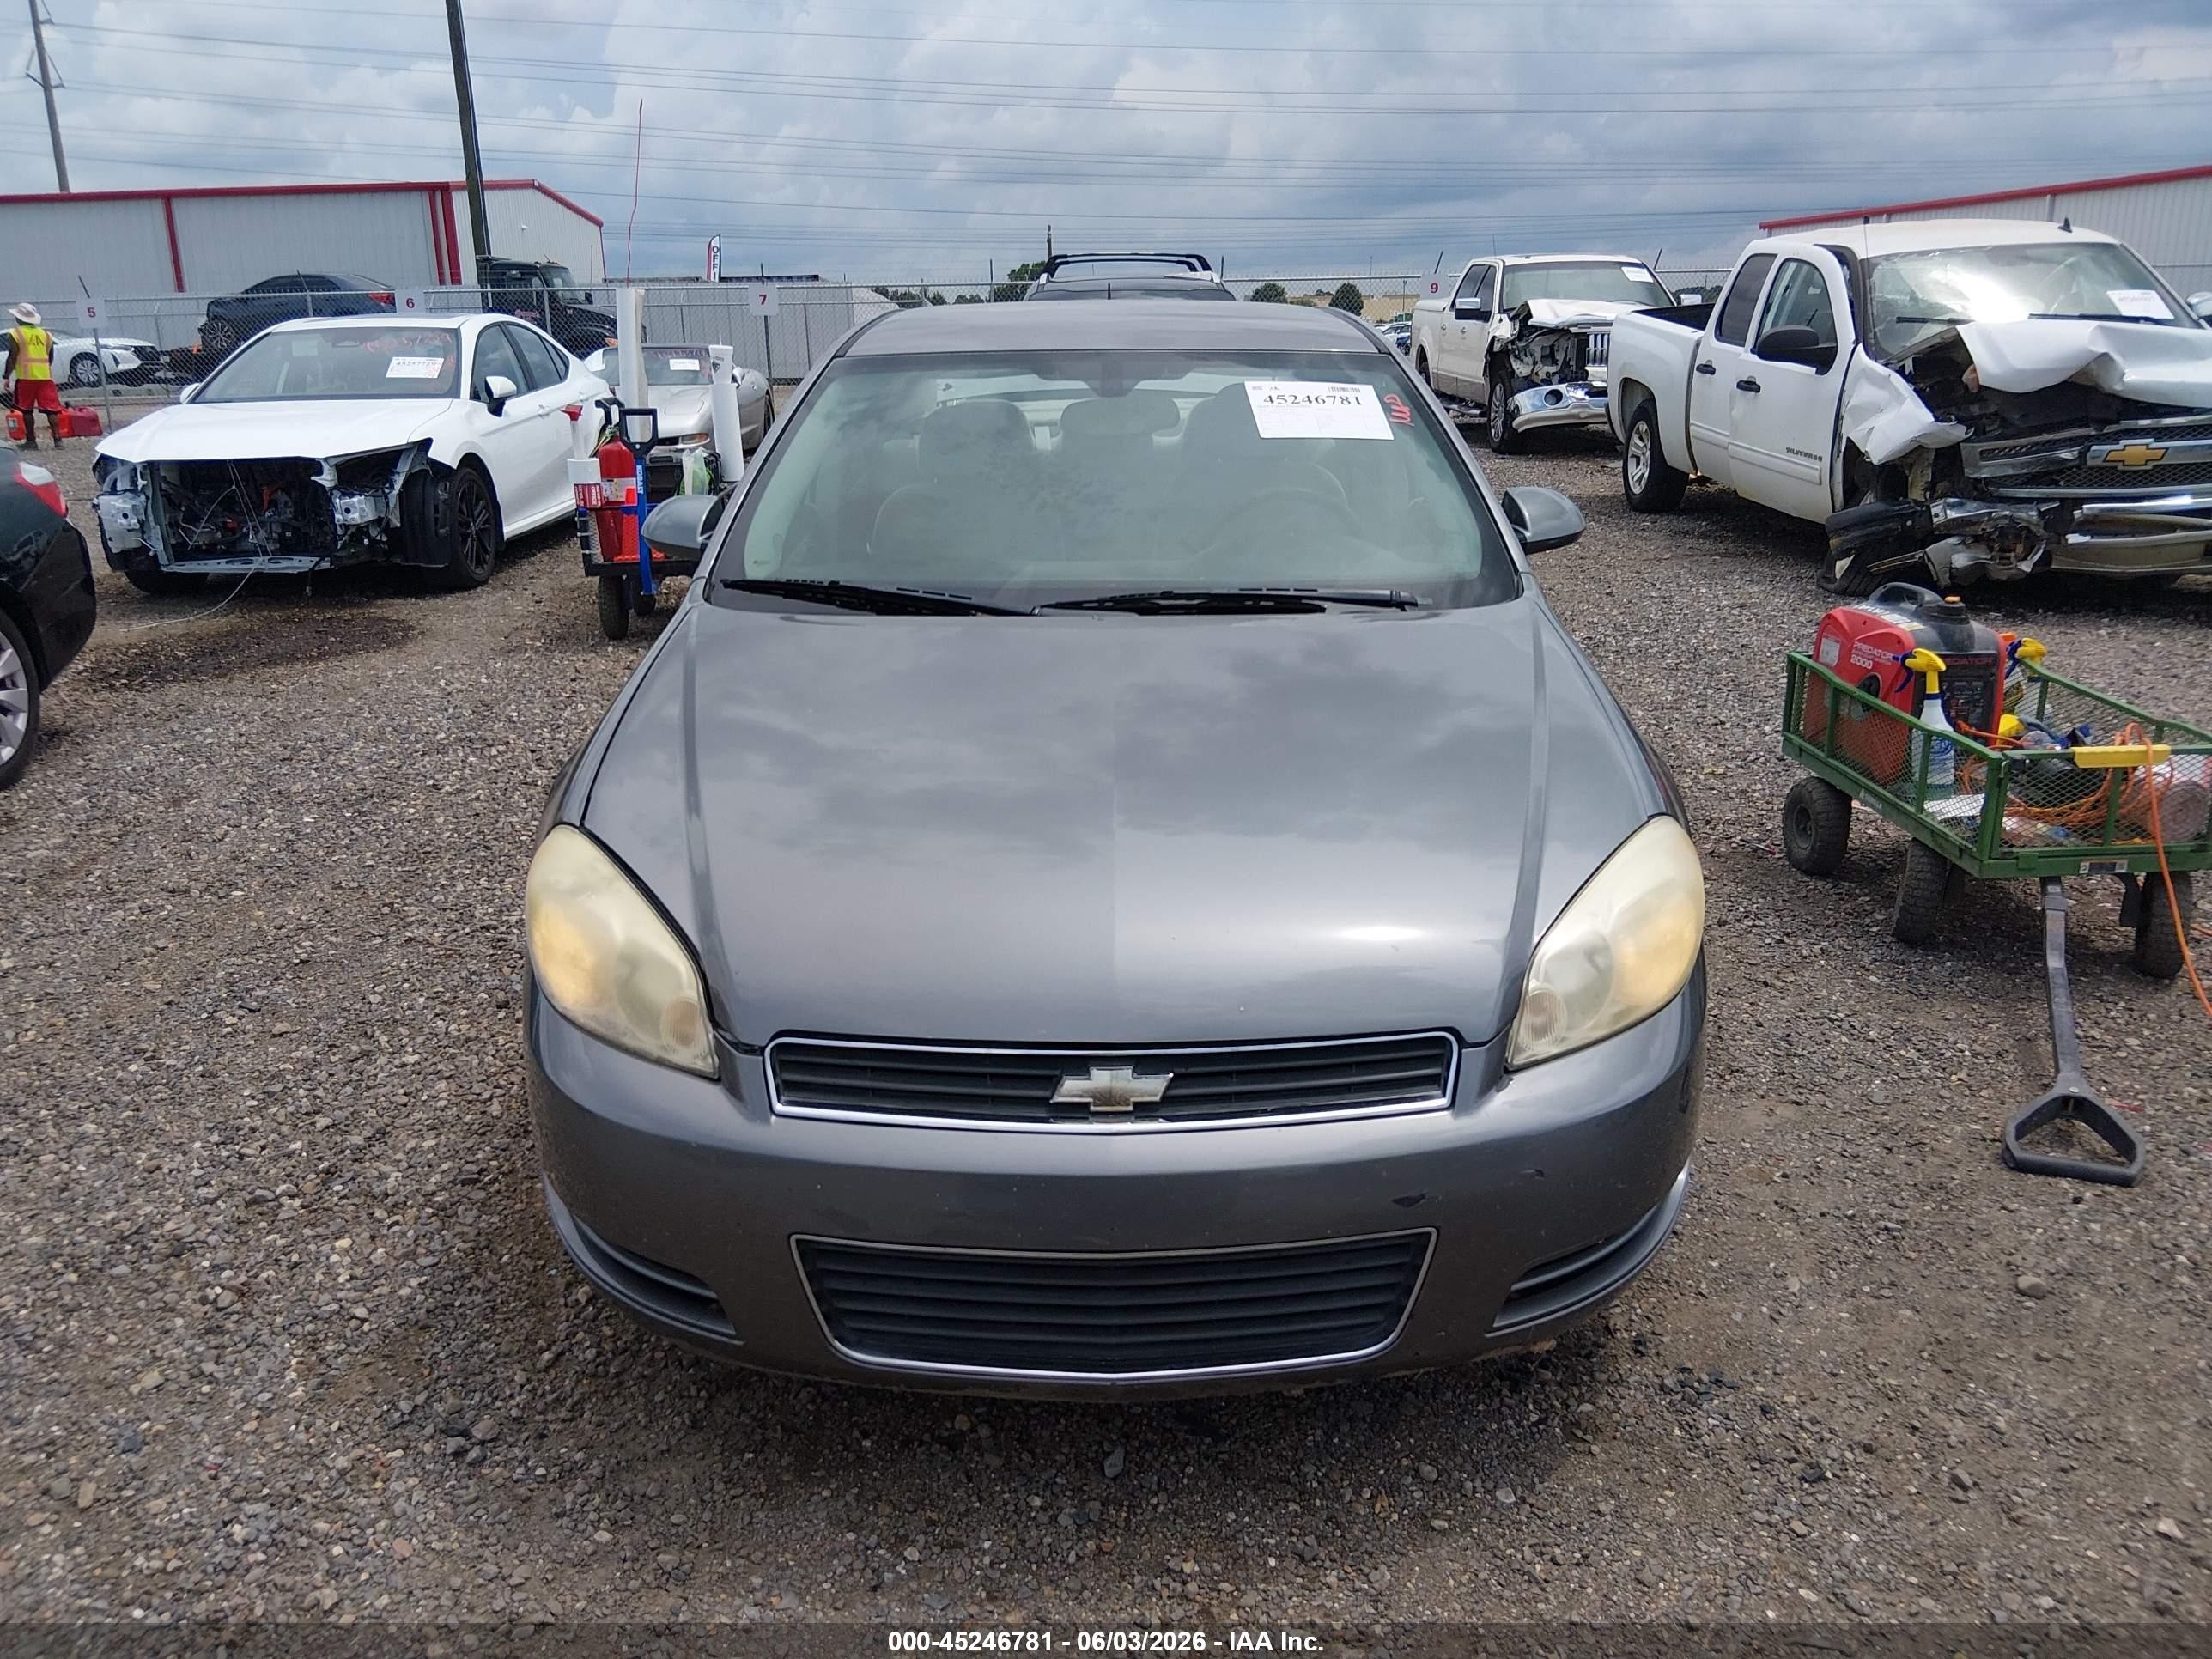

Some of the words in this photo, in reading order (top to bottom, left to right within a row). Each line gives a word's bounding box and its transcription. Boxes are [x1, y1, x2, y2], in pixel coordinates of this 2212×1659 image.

[1431, 283, 1439, 294] 9
[406, 297, 415, 309] 6
[758, 295, 767, 305] 7
[88, 307, 96, 318] 5
[1263, 394, 1361, 405] 45246781
[1850, 653, 1873, 670] 2000
